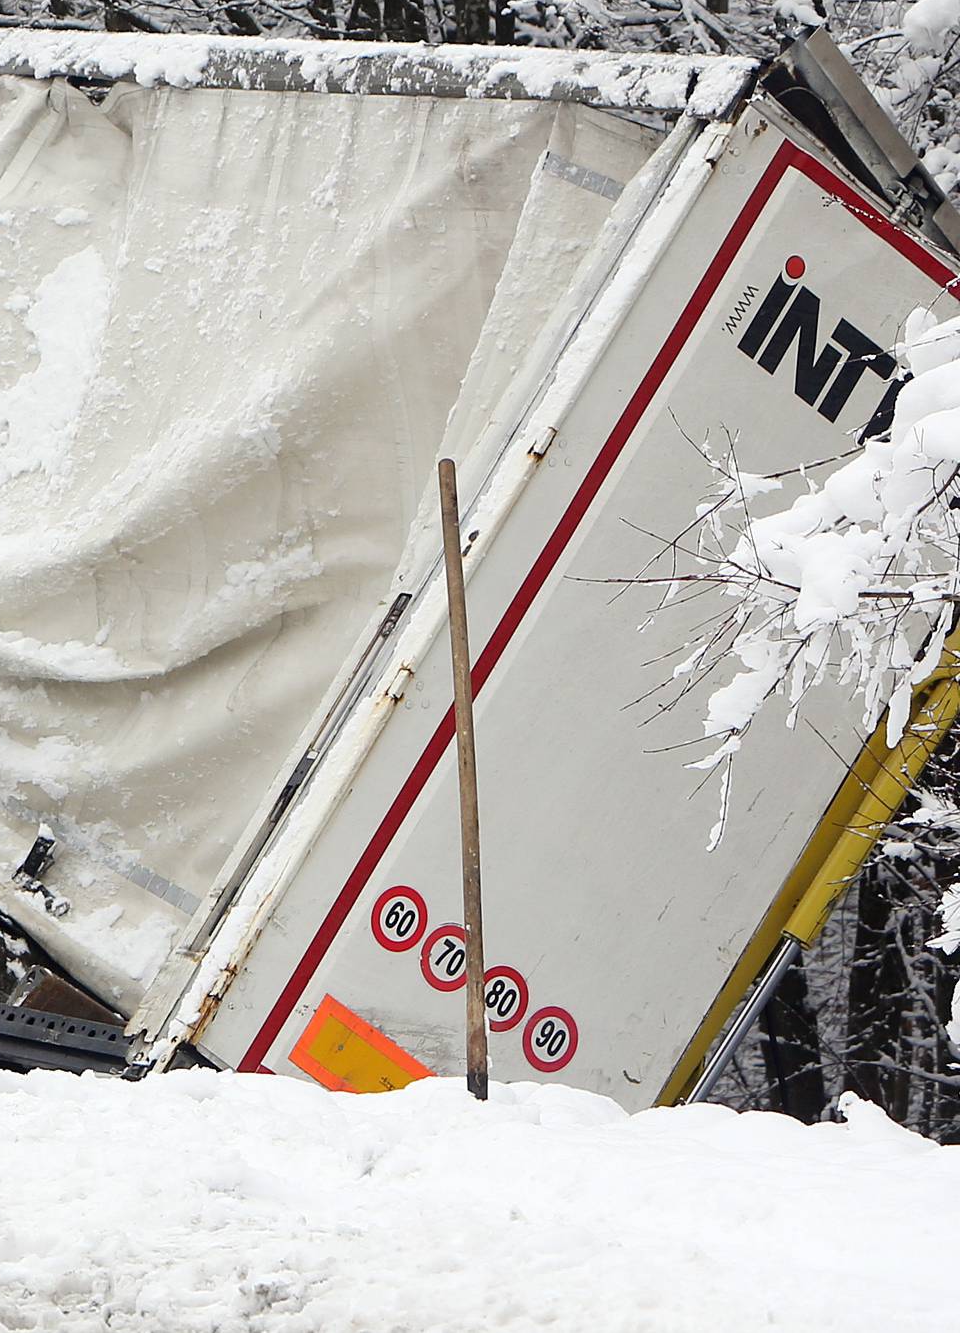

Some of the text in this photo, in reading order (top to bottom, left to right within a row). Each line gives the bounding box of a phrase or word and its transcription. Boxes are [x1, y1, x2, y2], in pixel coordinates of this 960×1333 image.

[384, 901, 416, 938] 60
[434, 938, 466, 977] 70
[485, 979, 518, 1017] 80
[535, 1020, 567, 1057] 90
